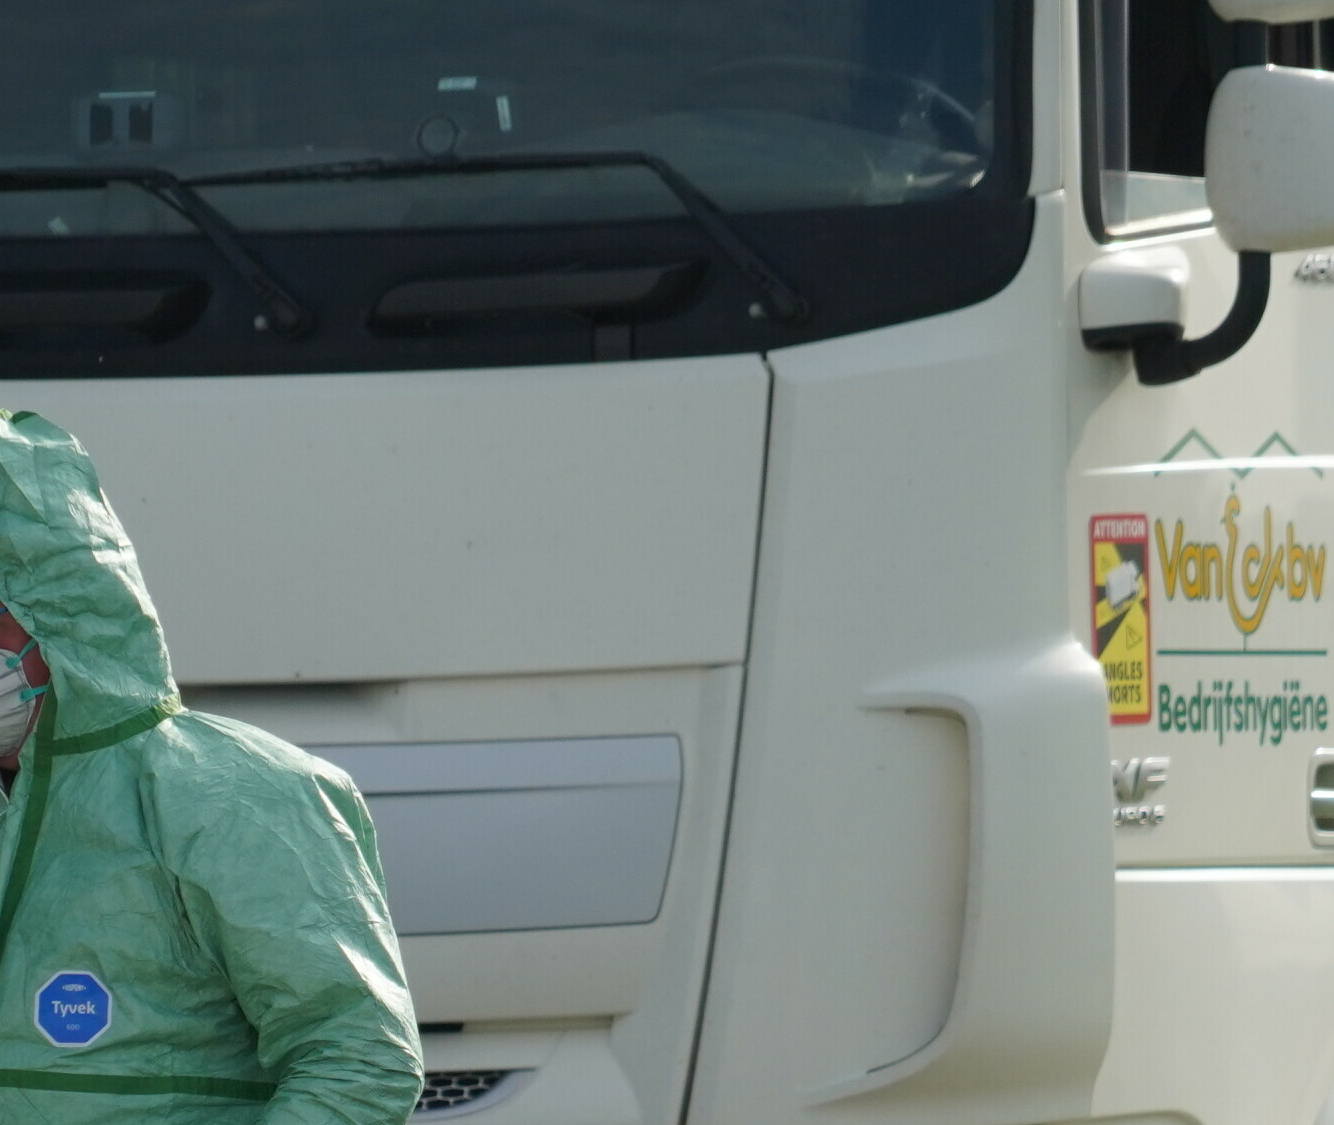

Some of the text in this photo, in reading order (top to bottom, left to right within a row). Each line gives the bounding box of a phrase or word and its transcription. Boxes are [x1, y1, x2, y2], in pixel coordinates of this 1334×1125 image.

[1093, 520, 1145, 539] ATTENTION
[1157, 680, 1328, 746] Bedrijfshygiëne
[51, 1000, 96, 1018] Tyvek
